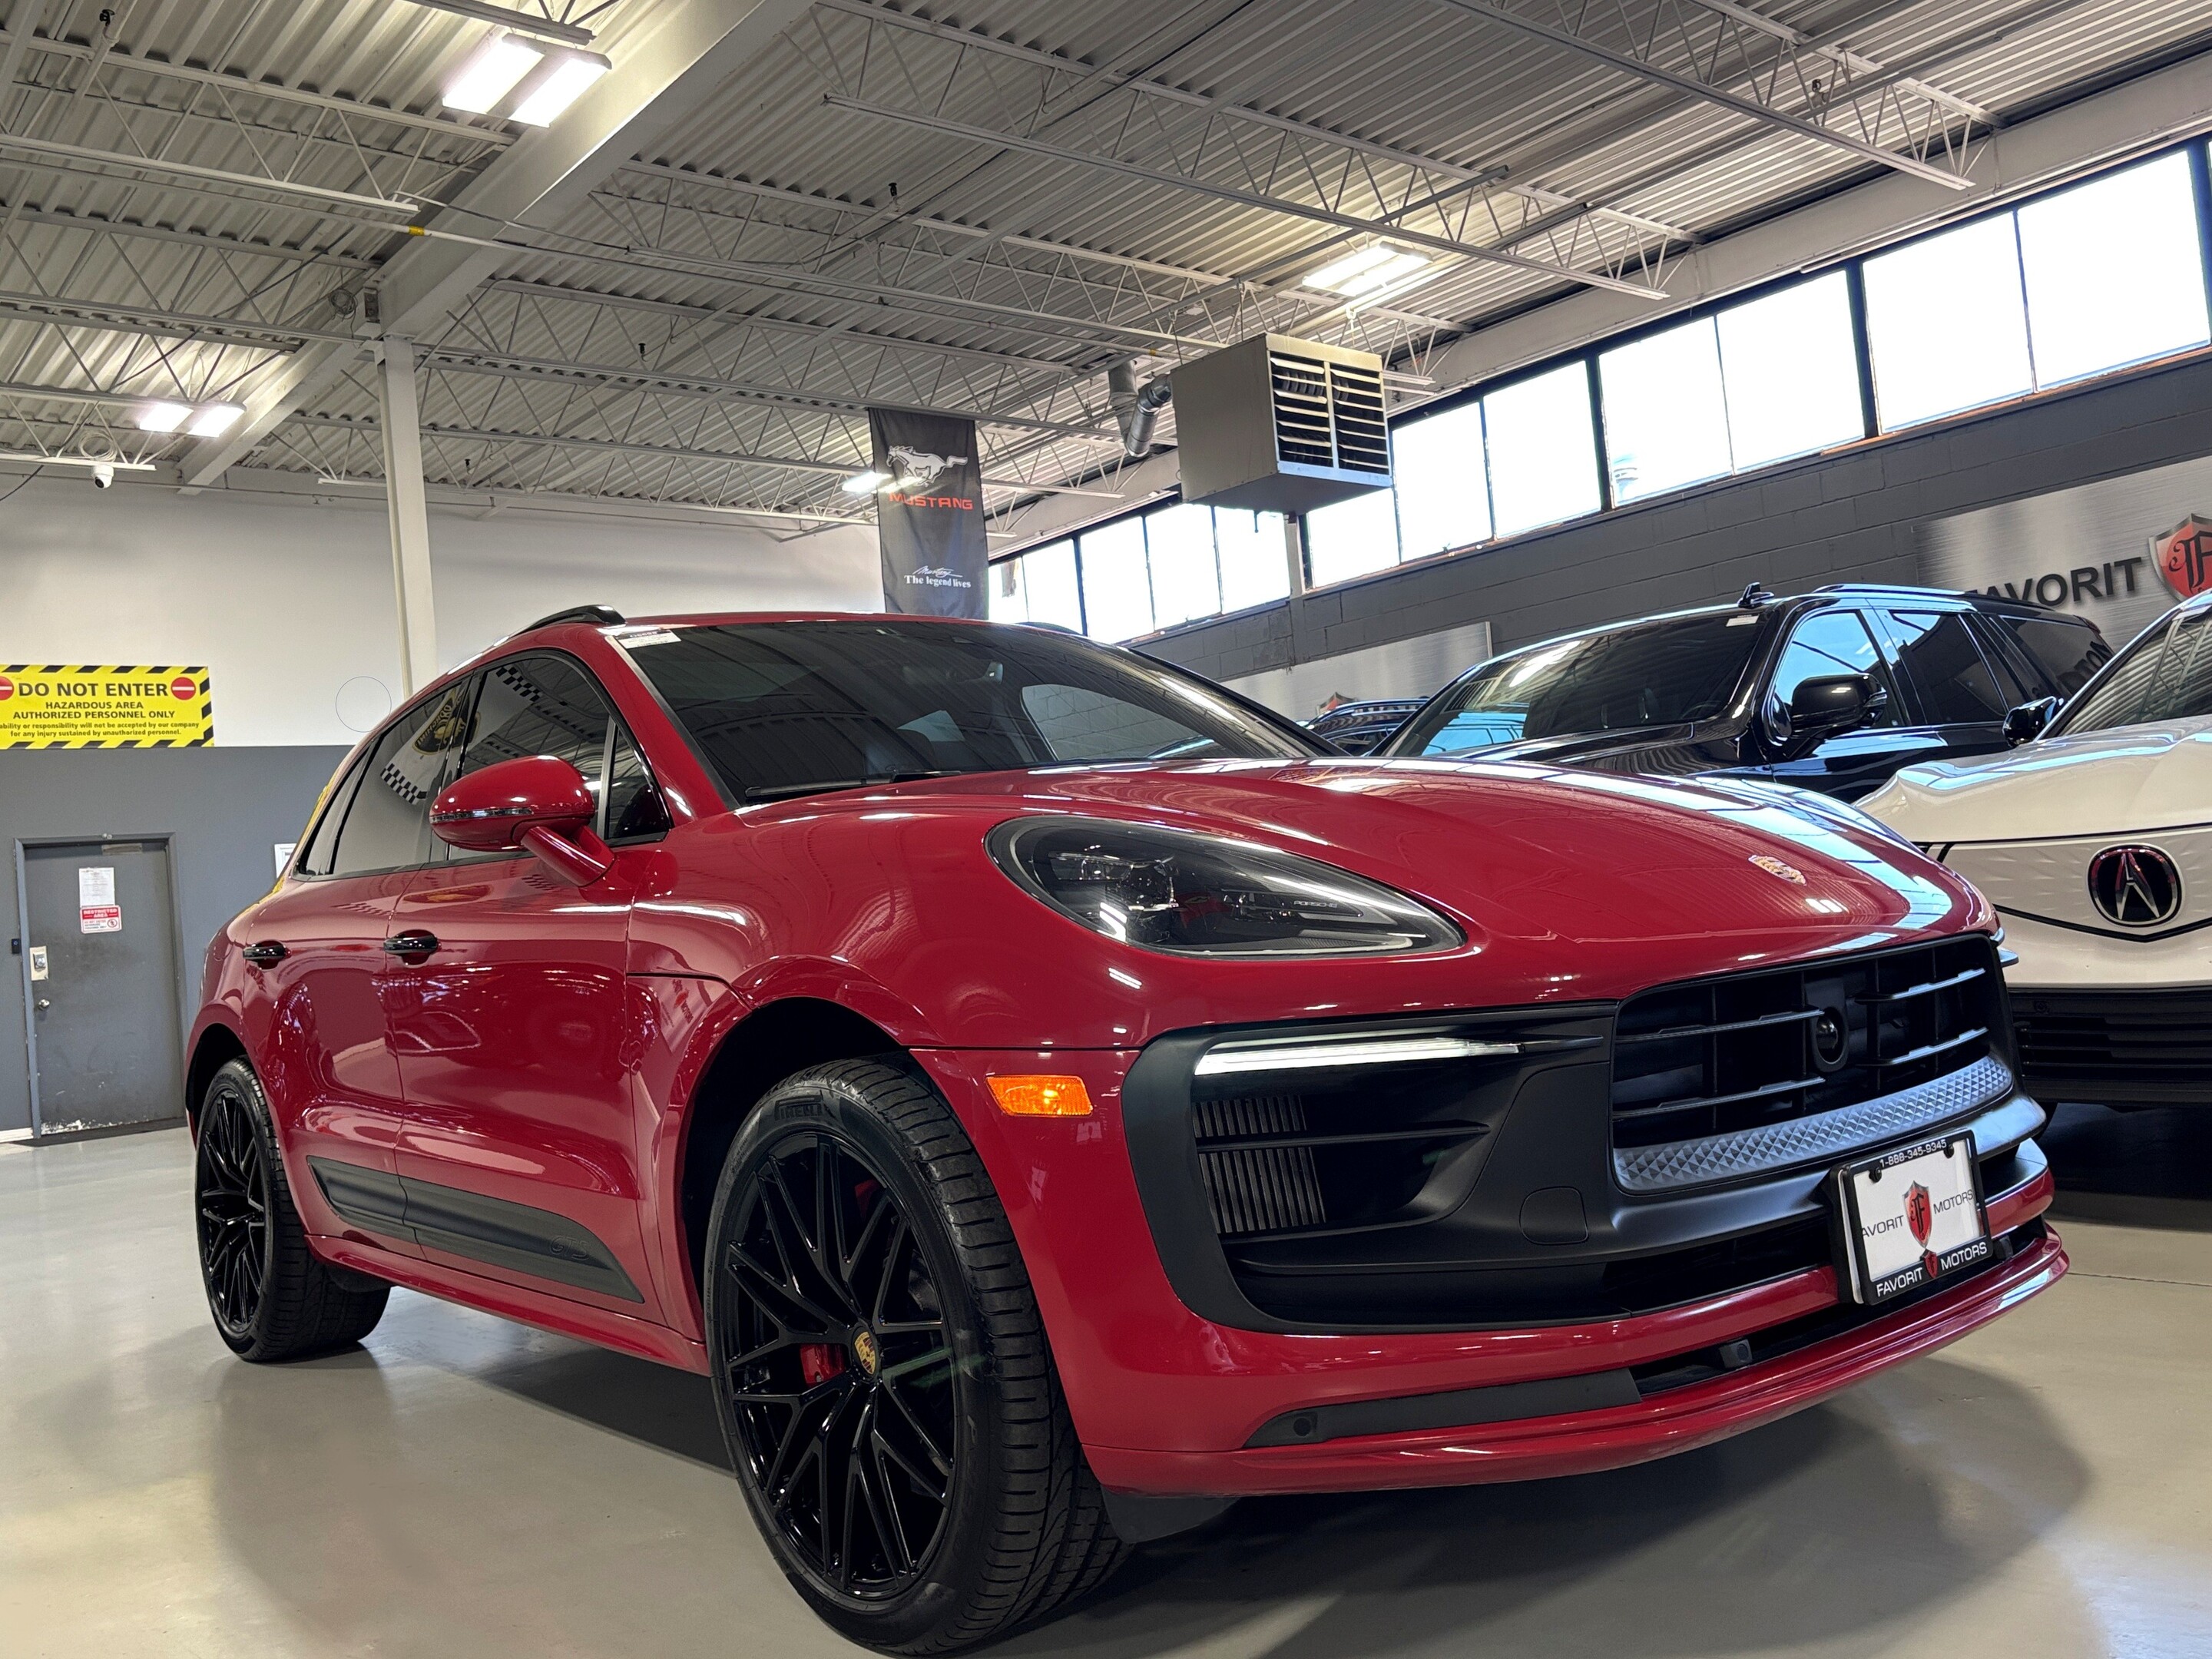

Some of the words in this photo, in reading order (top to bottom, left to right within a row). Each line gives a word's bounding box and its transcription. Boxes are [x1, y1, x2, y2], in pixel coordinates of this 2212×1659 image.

[889, 492, 973, 510] MUSTANG
[904, 575, 924, 584] The
[926, 576, 952, 588] legend
[953, 578, 971, 588] lives
[1966, 557, 2141, 608] VORIT
[18, 682, 49, 697] DO
[57, 683, 98, 697] NOT
[106, 683, 168, 697] ENTER
[1879, 1139, 1947, 1168] 1-888-345-9345
[1861, 1214, 1904, 1237] AVORIT
[1933, 1189, 1974, 1214] MOTORS
[550, 1235, 591, 1260] GTS
[1876, 1267, 1922, 1297] FAVORIT
[1940, 1242, 1987, 1270] MOTORS
